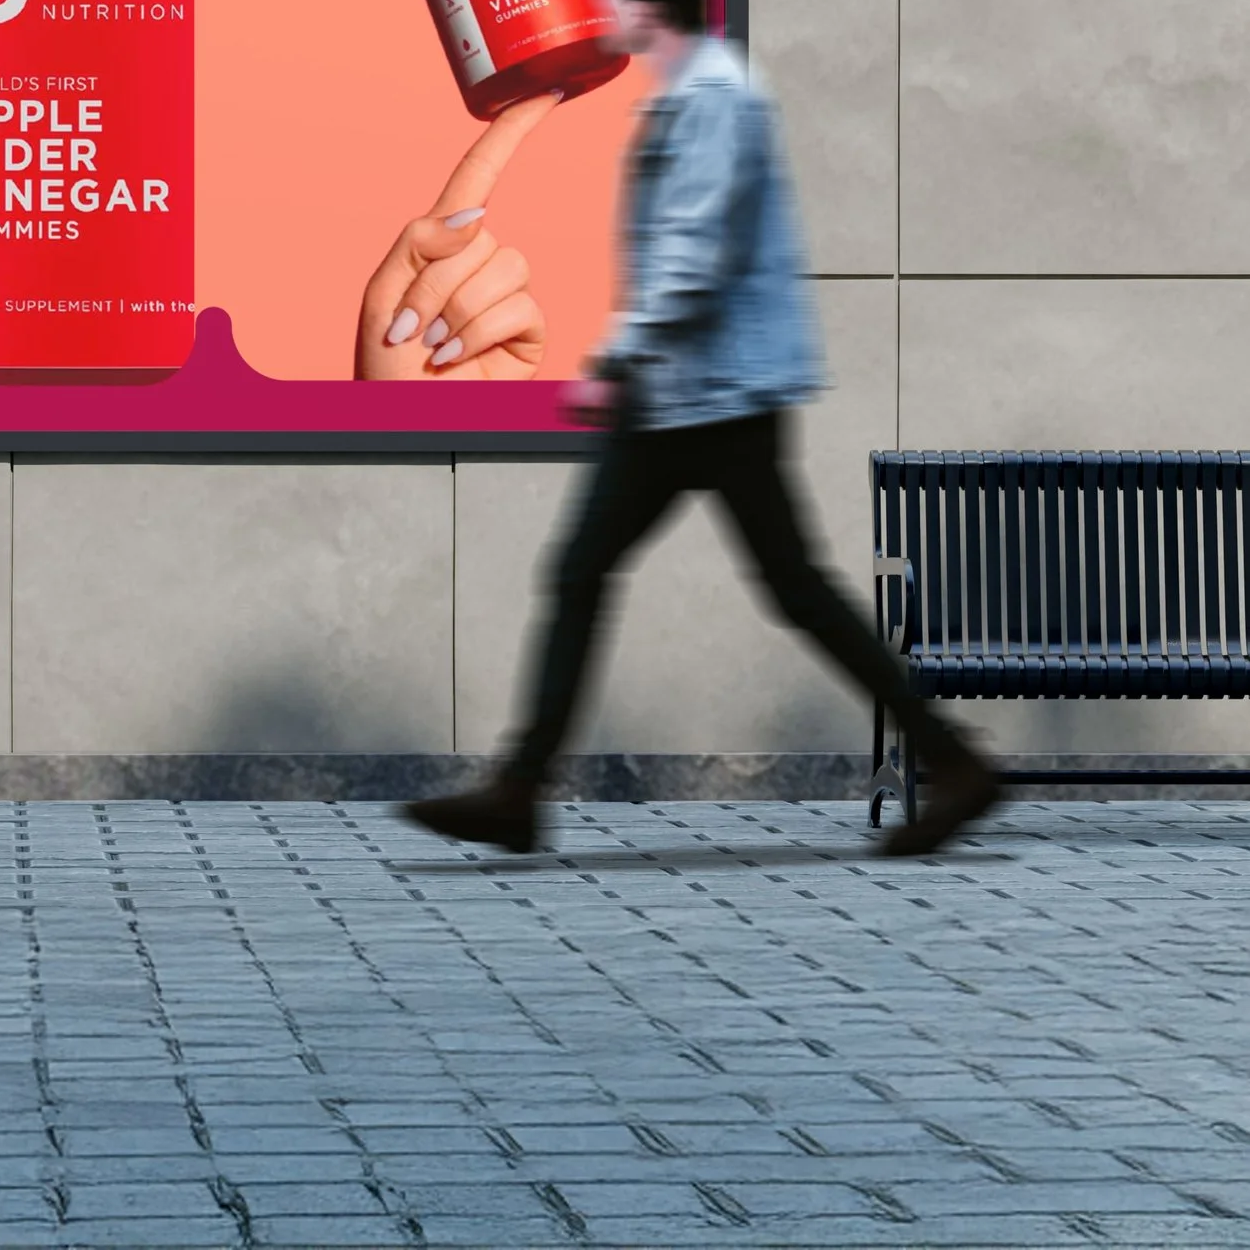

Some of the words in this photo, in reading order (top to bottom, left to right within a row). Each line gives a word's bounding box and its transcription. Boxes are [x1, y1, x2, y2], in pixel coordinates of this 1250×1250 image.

[42, 3, 185, 20] NUTRITION
[46, 76, 99, 92] FIRST
[5, 299, 113, 312] SUPPLEMENT
[130, 299, 165, 312] with
[170, 299, 195, 312] the
